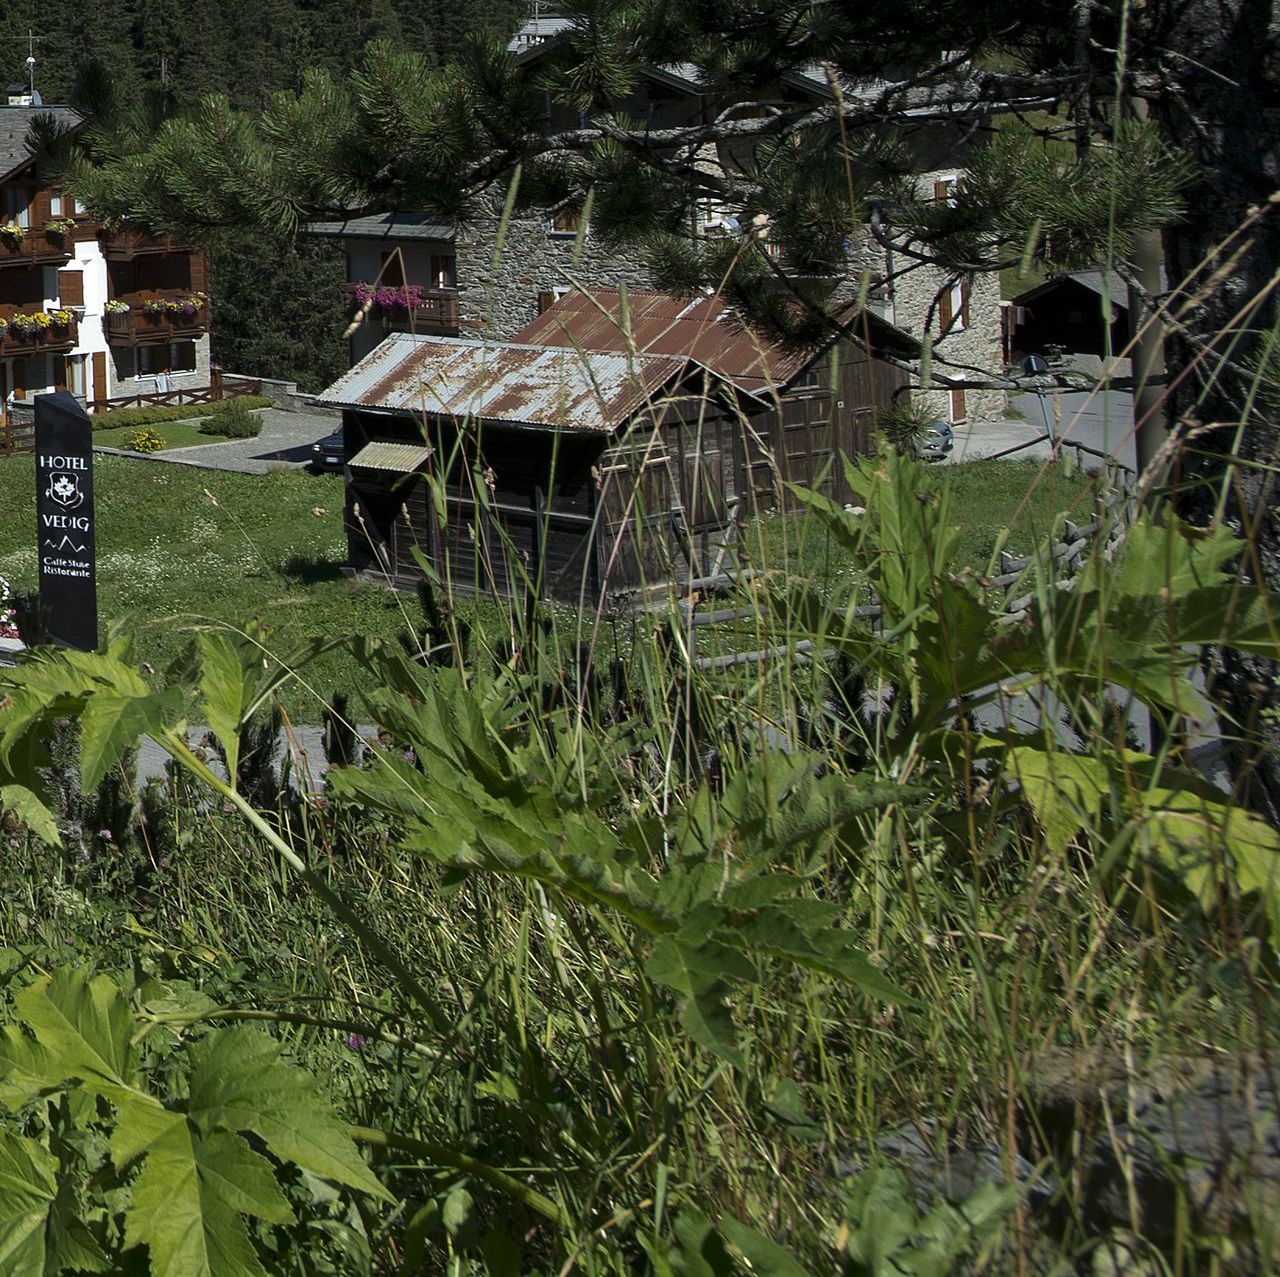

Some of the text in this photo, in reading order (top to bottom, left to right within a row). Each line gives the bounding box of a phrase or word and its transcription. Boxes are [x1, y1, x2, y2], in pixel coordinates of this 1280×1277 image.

[40, 455, 88, 470] HOTEL
[42, 514, 90, 532] VEDIG
[43, 565, 91, 578] Ristorante
